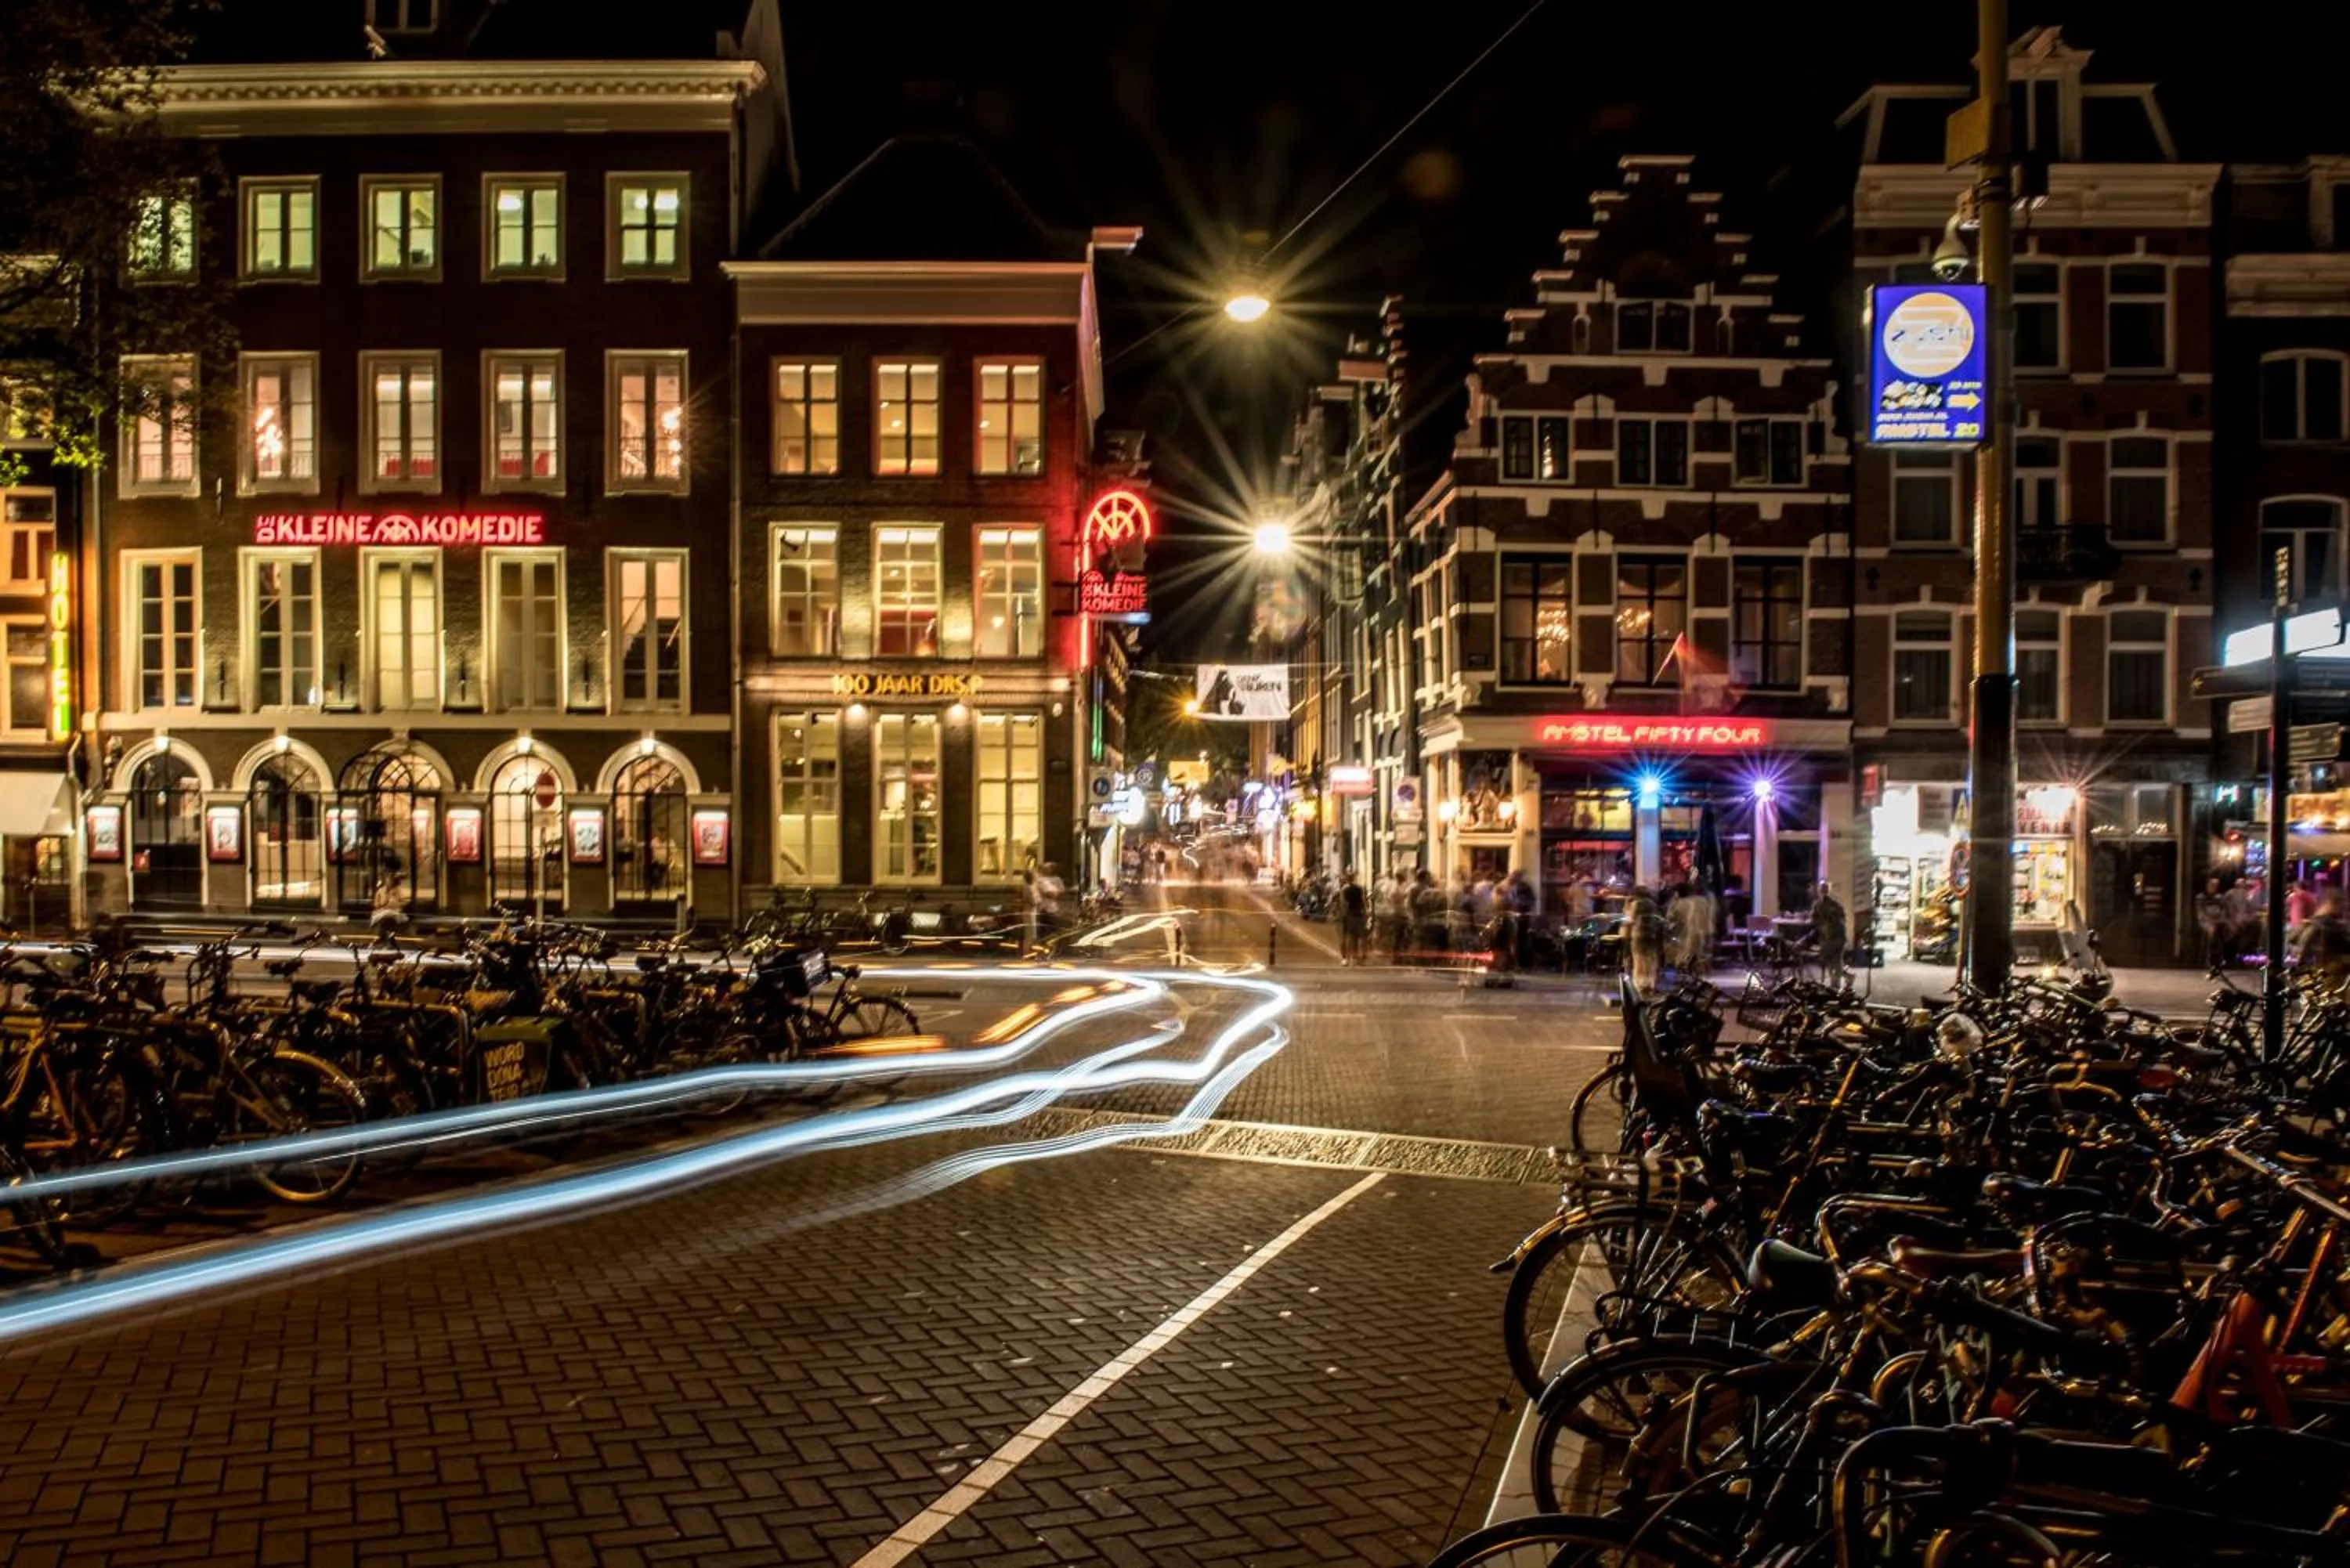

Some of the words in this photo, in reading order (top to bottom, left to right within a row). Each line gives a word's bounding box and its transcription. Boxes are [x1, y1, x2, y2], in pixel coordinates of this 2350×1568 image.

[277, 515, 372, 542] KLEINE
[421, 515, 542, 543] KOMEDIE
[1093, 582, 1147, 597] KLEINE
[1080, 598, 1148, 612] KOMEDIE
[51, 551, 70, 741] HOTEL
[831, 675, 870, 695] 100
[875, 675, 922, 695] JAAR
[1542, 724, 1632, 742] AMSTEL
[1634, 726, 1695, 742] FIFTY
[1697, 726, 1761, 743] FOUR
